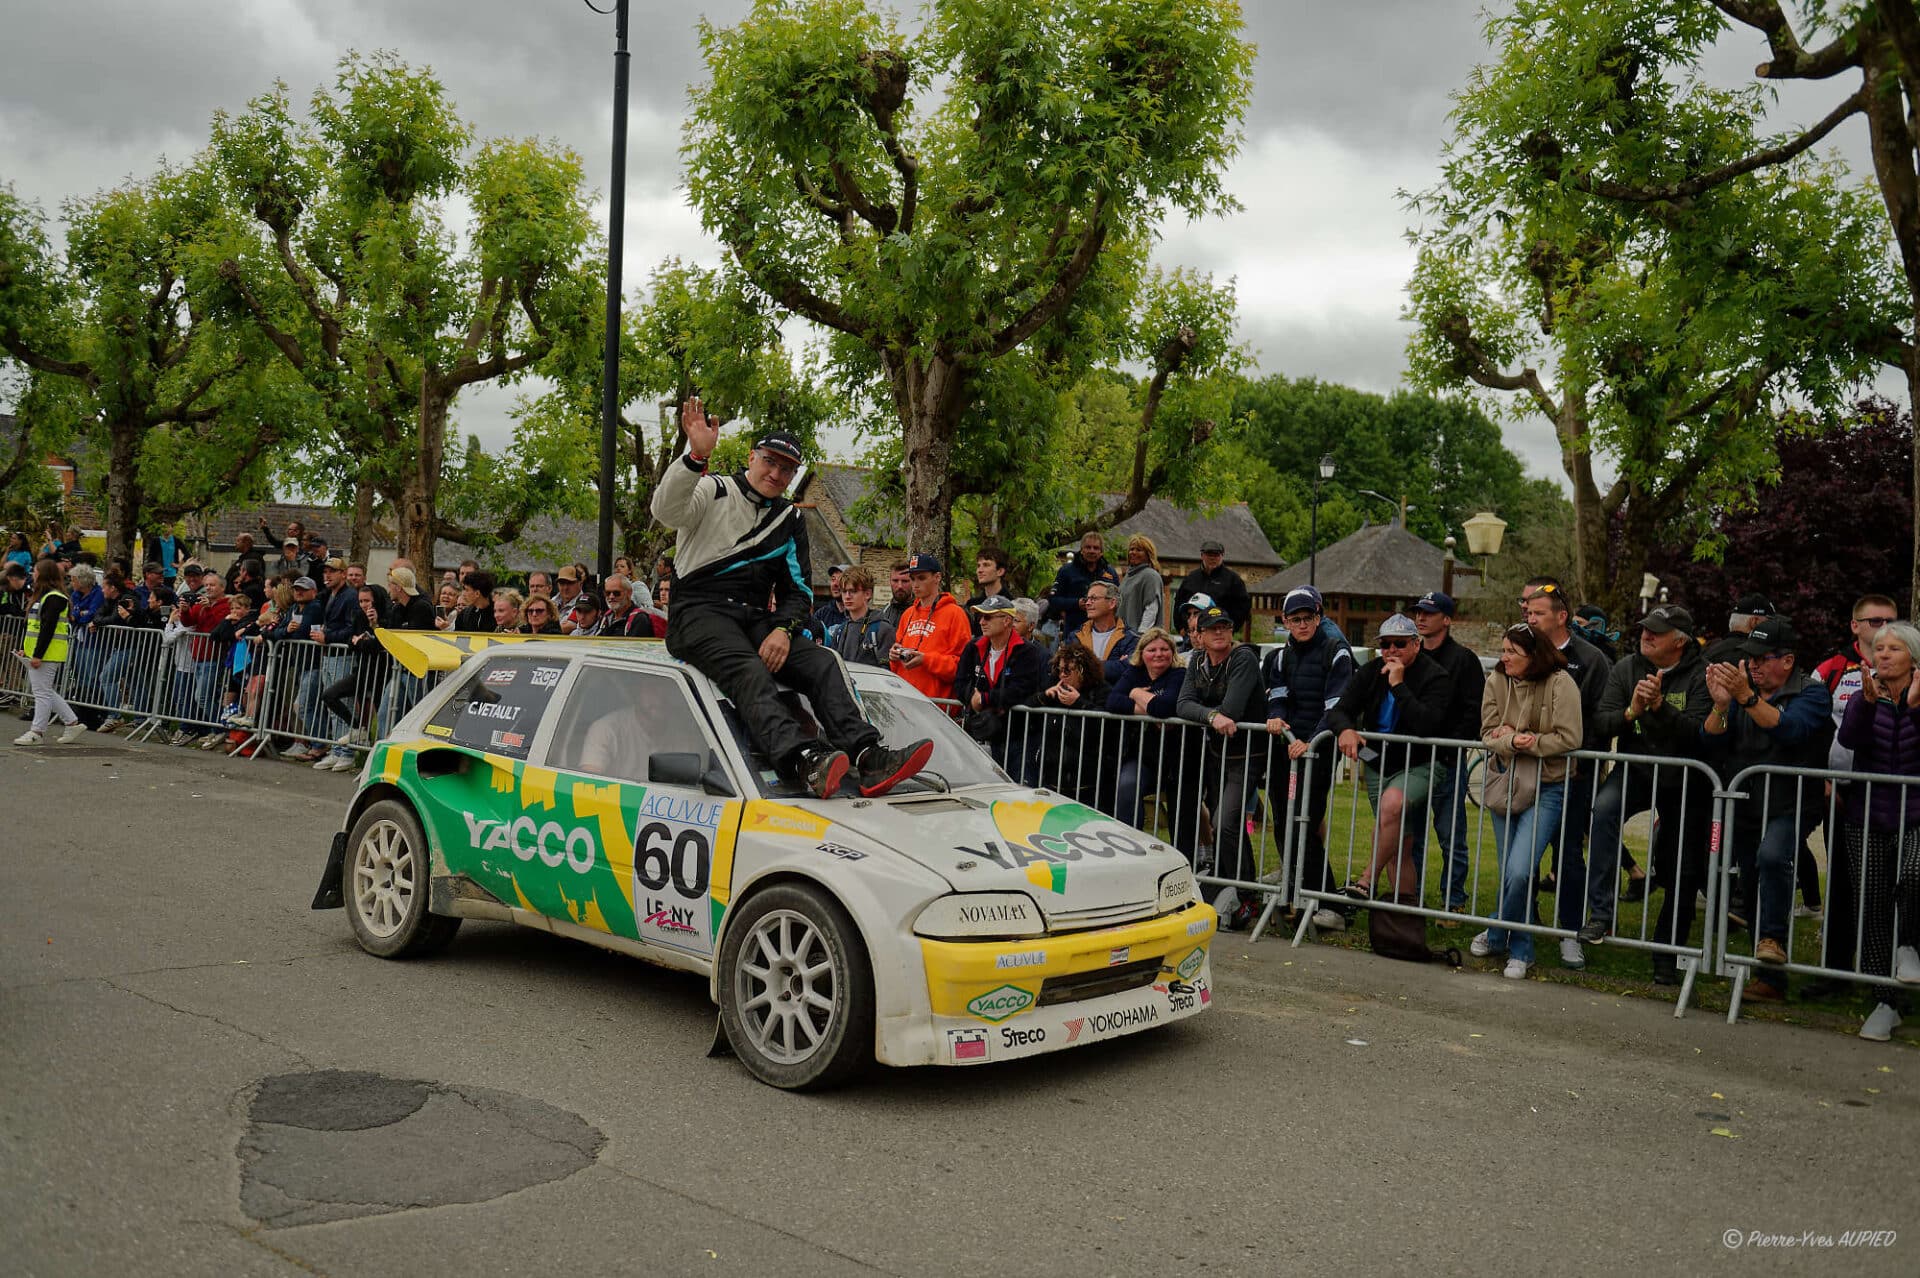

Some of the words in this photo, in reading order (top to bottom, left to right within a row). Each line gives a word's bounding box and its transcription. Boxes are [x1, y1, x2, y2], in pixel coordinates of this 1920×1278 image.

[468, 701, 521, 720] C.VETAULT
[645, 794, 722, 826] ACUVUE
[463, 810, 596, 874] YACCO
[953, 831, 1147, 869] YACCO
[635, 821, 710, 899] 60
[671, 905, 694, 925] NY
[960, 904, 1027, 923] NOVAMAX
[998, 952, 1045, 968] ACUVUE
[977, 995, 1028, 1011] YACCO
[1168, 994, 1194, 1013] Steco
[1088, 1004, 1158, 1033] YOKOHAMA
[1001, 1028, 1046, 1048] Steco
